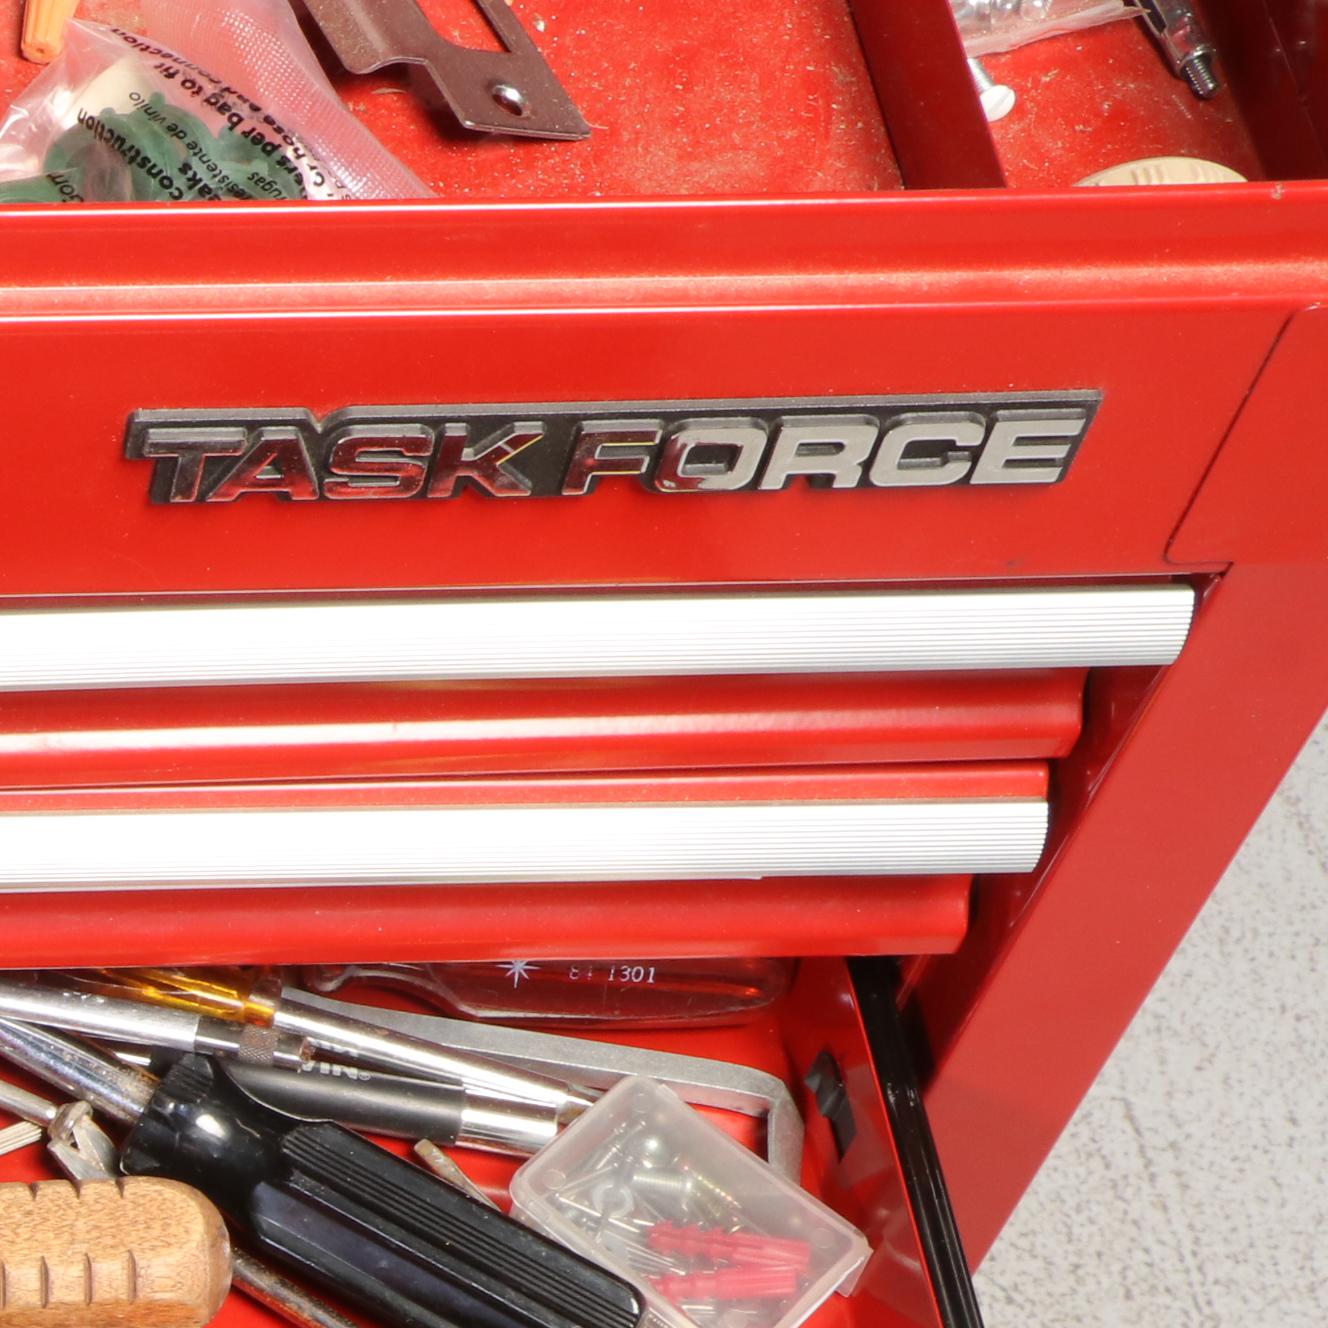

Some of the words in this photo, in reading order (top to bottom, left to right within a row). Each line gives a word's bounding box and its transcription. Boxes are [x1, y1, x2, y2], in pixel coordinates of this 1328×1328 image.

[154, 62, 180, 79] fit
[181, 76, 206, 97] to
[203, 92, 244, 129] bag
[167, 123, 186, 140] de
[241, 126, 282, 154] per
[78, 108, 183, 200] construction
[144, 420, 546, 503] TASK
[558, 408, 1088, 499] FORCE
[608, 965, 656, 984] 1301
